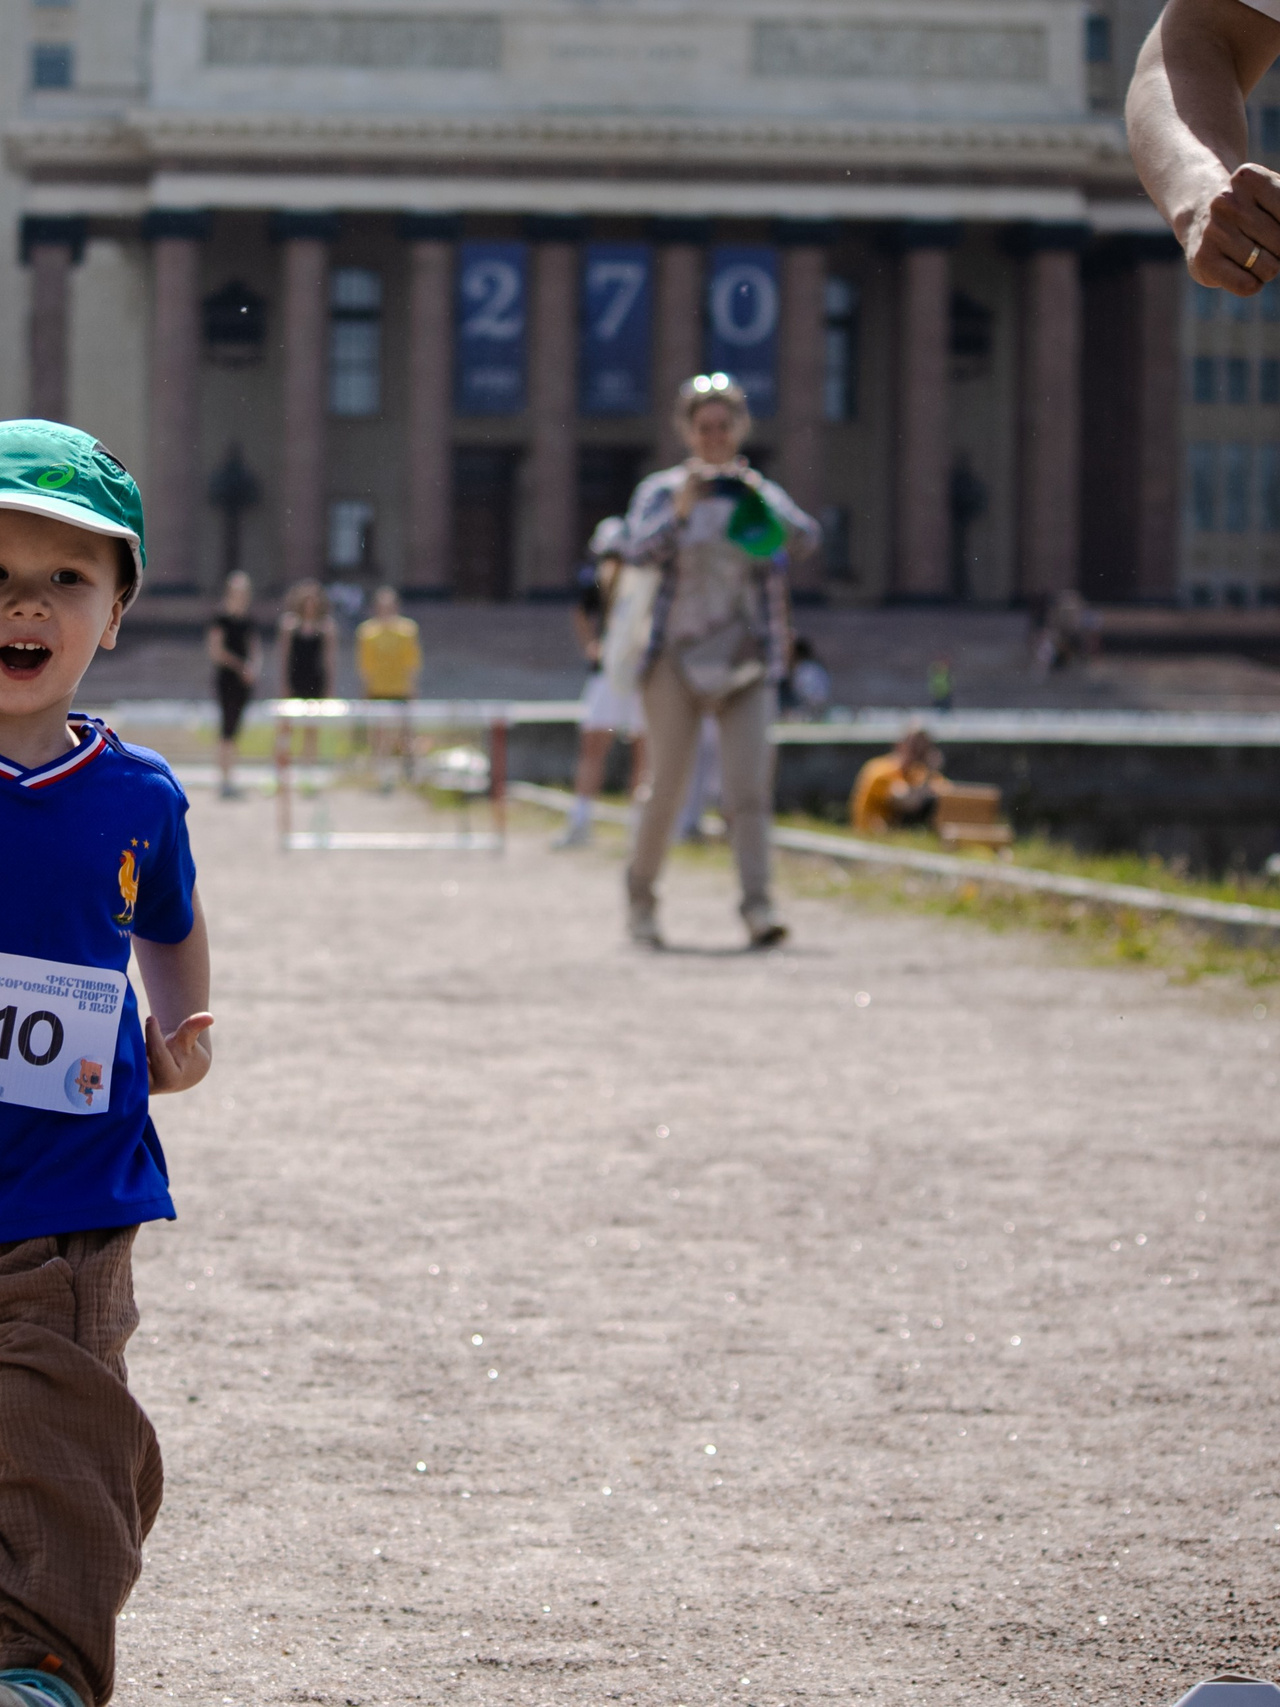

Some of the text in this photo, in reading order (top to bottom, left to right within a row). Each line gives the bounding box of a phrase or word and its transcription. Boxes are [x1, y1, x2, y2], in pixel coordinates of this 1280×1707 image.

[461, 258, 777, 346] 2 7 0
[46, 975, 119, 994] ФЕСТИВАЛЬ
[72, 989, 118, 1004] СПОРТА
[78, 1001, 86, 1011] В
